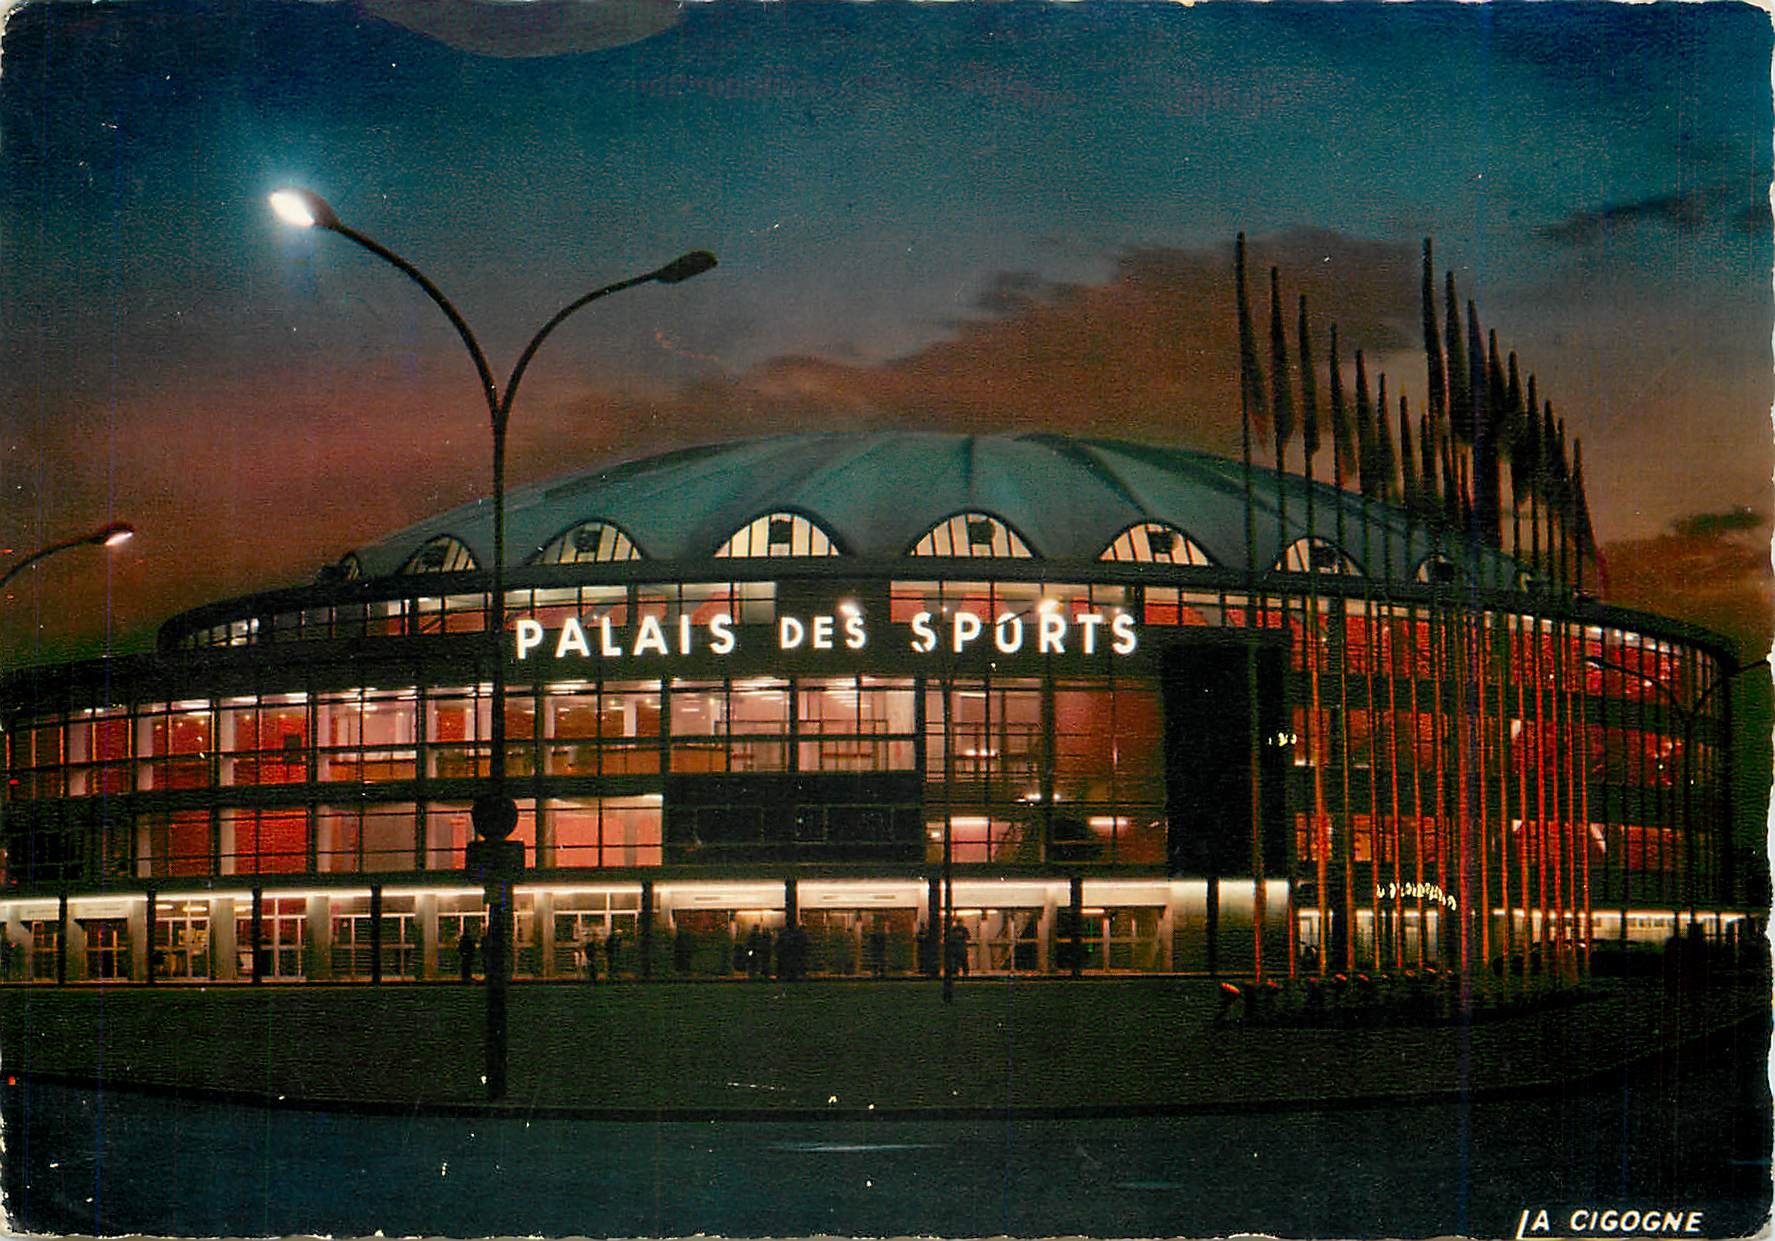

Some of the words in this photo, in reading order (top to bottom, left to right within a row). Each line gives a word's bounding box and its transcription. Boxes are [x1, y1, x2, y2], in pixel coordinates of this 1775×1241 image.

[515, 612, 736, 660] PALAIS
[779, 614, 867, 649] DES
[911, 610, 1138, 655] SPORTS
